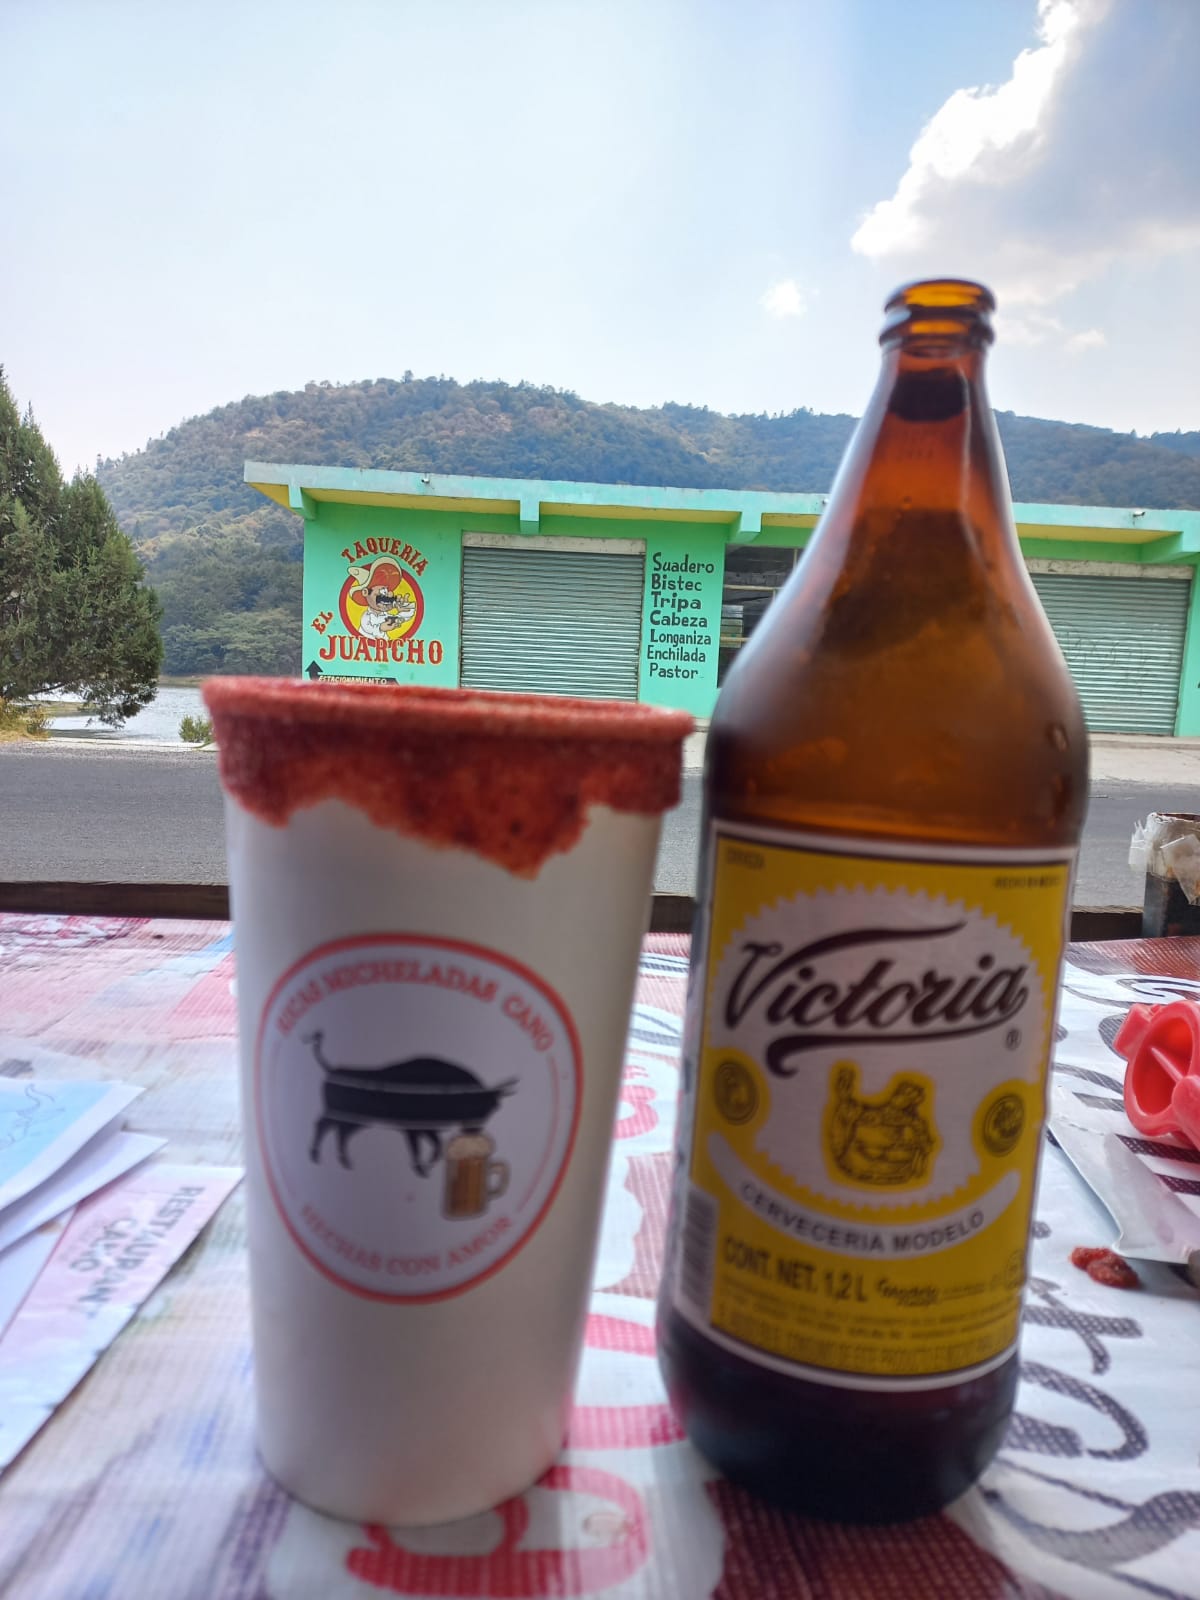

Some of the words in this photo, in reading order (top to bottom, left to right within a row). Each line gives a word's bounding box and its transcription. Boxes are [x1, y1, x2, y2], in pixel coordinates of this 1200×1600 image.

[341, 537, 429, 576] TAQUERIA
[652, 552, 715, 573] Suadero
[651, 573, 702, 591] Bistec
[651, 591, 702, 612] Tripa
[311, 611, 334, 634] EL
[650, 610, 708, 628] Cabeza
[319, 634, 443, 664] JUARCHO
[650, 629, 712, 648] Longaniza
[647, 645, 706, 662] Enchilada
[650, 663, 698, 679] Pastor
[724, 923, 1029, 1078] Victoria
[502, 995, 554, 1053] CANO
[741, 1181, 885, 1252] CERVECERIA
[896, 1210, 985, 1252] MODELO
